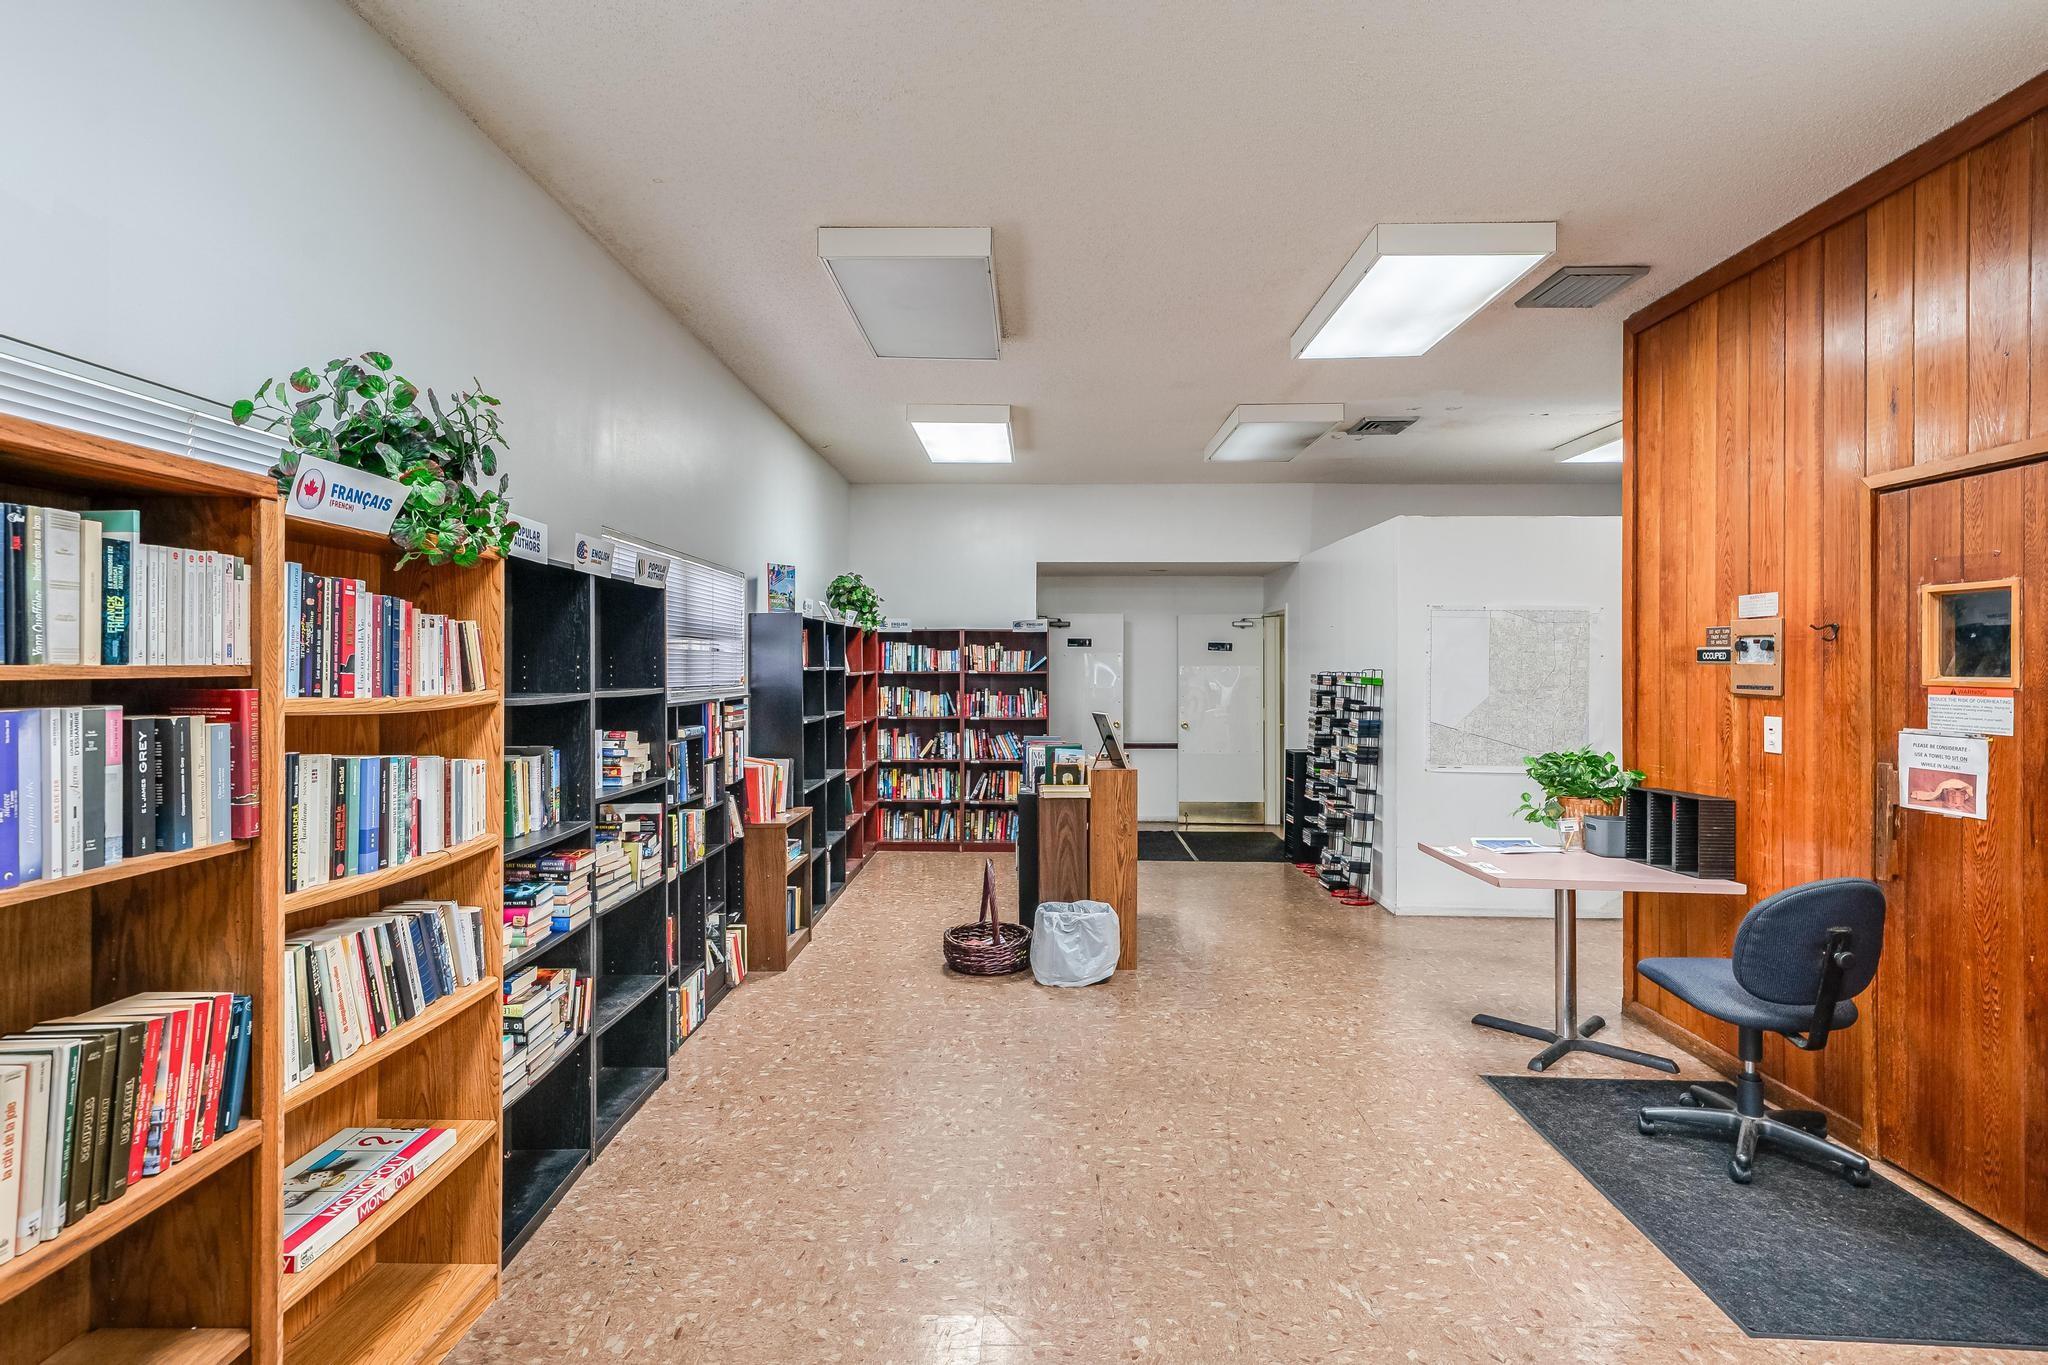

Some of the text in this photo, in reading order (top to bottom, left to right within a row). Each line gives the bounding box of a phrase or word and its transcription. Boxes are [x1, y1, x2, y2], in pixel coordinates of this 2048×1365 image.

[331, 483, 392, 511] FRANÇAIS
[329, 499, 355, 512] (FRENCH)
[516, 527, 541, 542] OPULAR
[514, 537, 541, 553] AUTHORS
[591, 549, 610, 562] ENGLISH
[648, 562, 667, 574] POPULAR
[107, 596, 115, 633] FRANCK
[114, 596, 124, 632] THILLIEZ
[32, 634, 42, 656] Yann
[357, 633, 365, 670] nouvelle
[1702, 652, 1727, 660] OCCUPIED
[250, 697, 258, 710] THE
[251, 712, 259, 722] DA
[251, 724, 259, 742] VINCI
[138, 731, 148, 773] GREY
[251, 745, 259, 762] CODE
[1936, 744, 1967, 752] CONSIDERATE
[251, 768, 259, 782] DAN
[3, 793, 11, 817] silence
[342, 1025, 349, 1034] le
[206, 1088, 214, 1102] Saga
[185, 1098, 193, 1112] Saga
[65, 1116, 73, 1131] Sud
[134, 1121, 142, 1135] Saga
[163, 1124, 169, 1132] La
[2, 1102, 17, 1180] la cité de la joie
[133, 1136, 140, 1145] La
[321, 1156, 408, 1217] MONOPOLY
[359, 1166, 415, 1220] MONOLY
